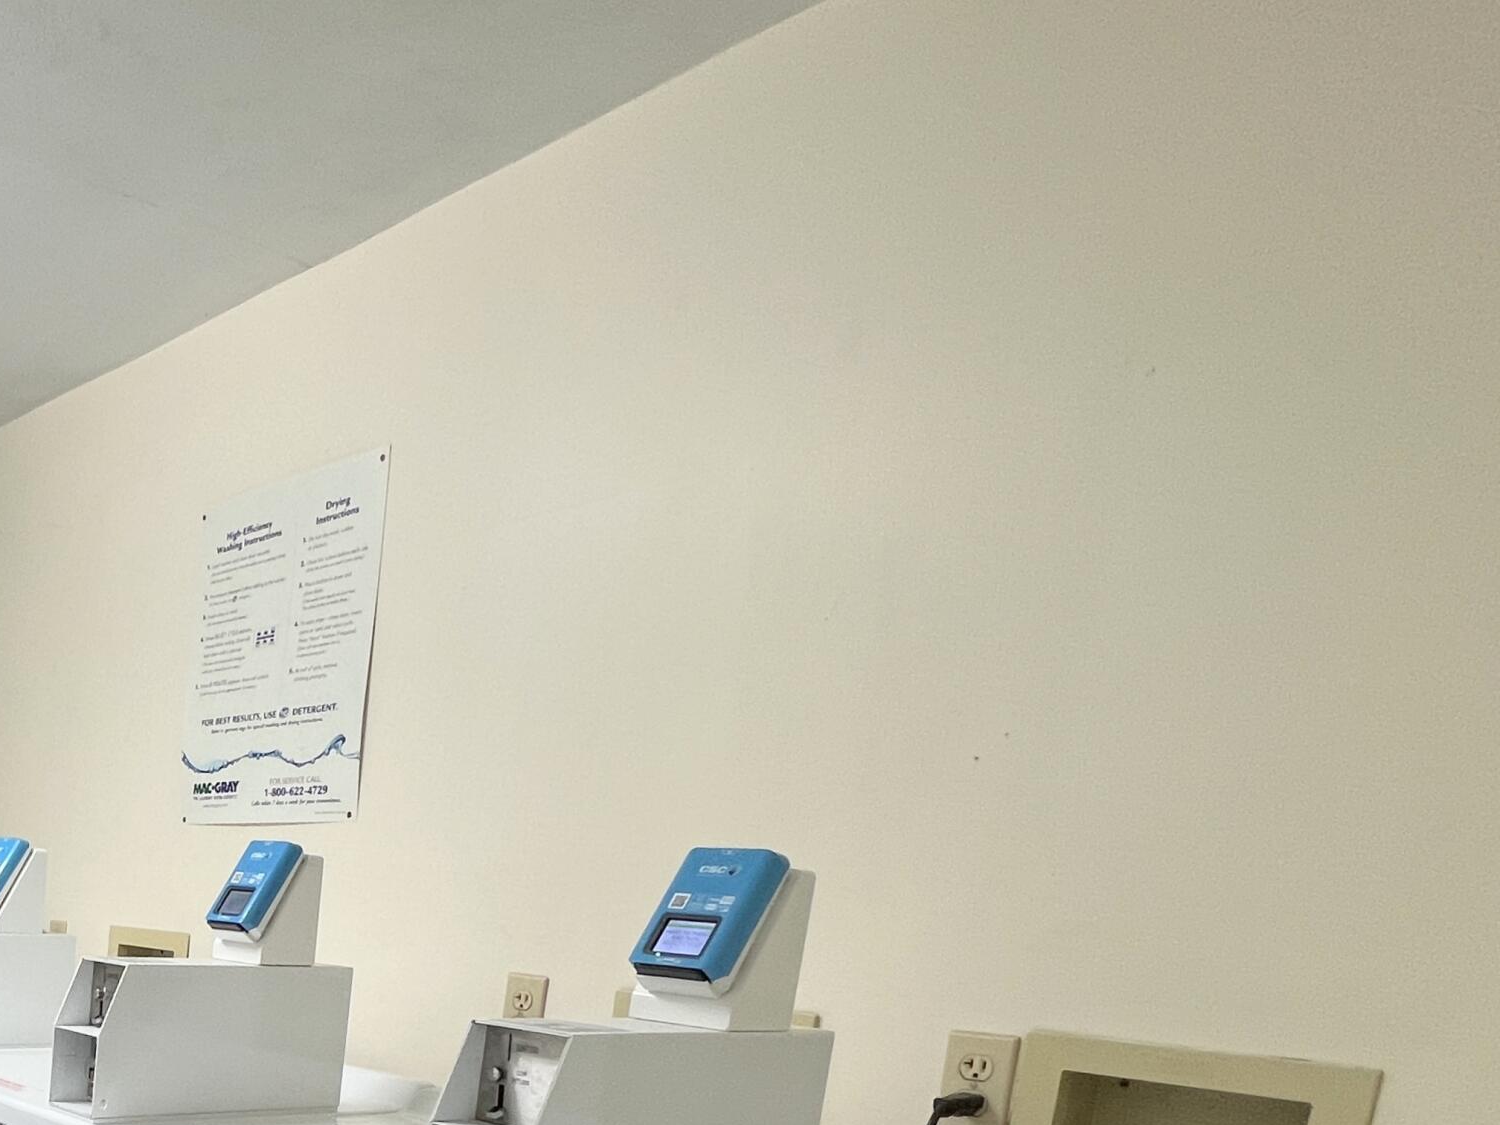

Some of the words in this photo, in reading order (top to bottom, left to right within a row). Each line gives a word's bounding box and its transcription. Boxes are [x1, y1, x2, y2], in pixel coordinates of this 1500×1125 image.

[316, 507, 359, 525] Instructions
[202, 718, 214, 727] FOR
[215, 716, 231, 726] BEST
[263, 710, 277, 720] USE
[264, 785, 328, 797] 1-800-622-4729
